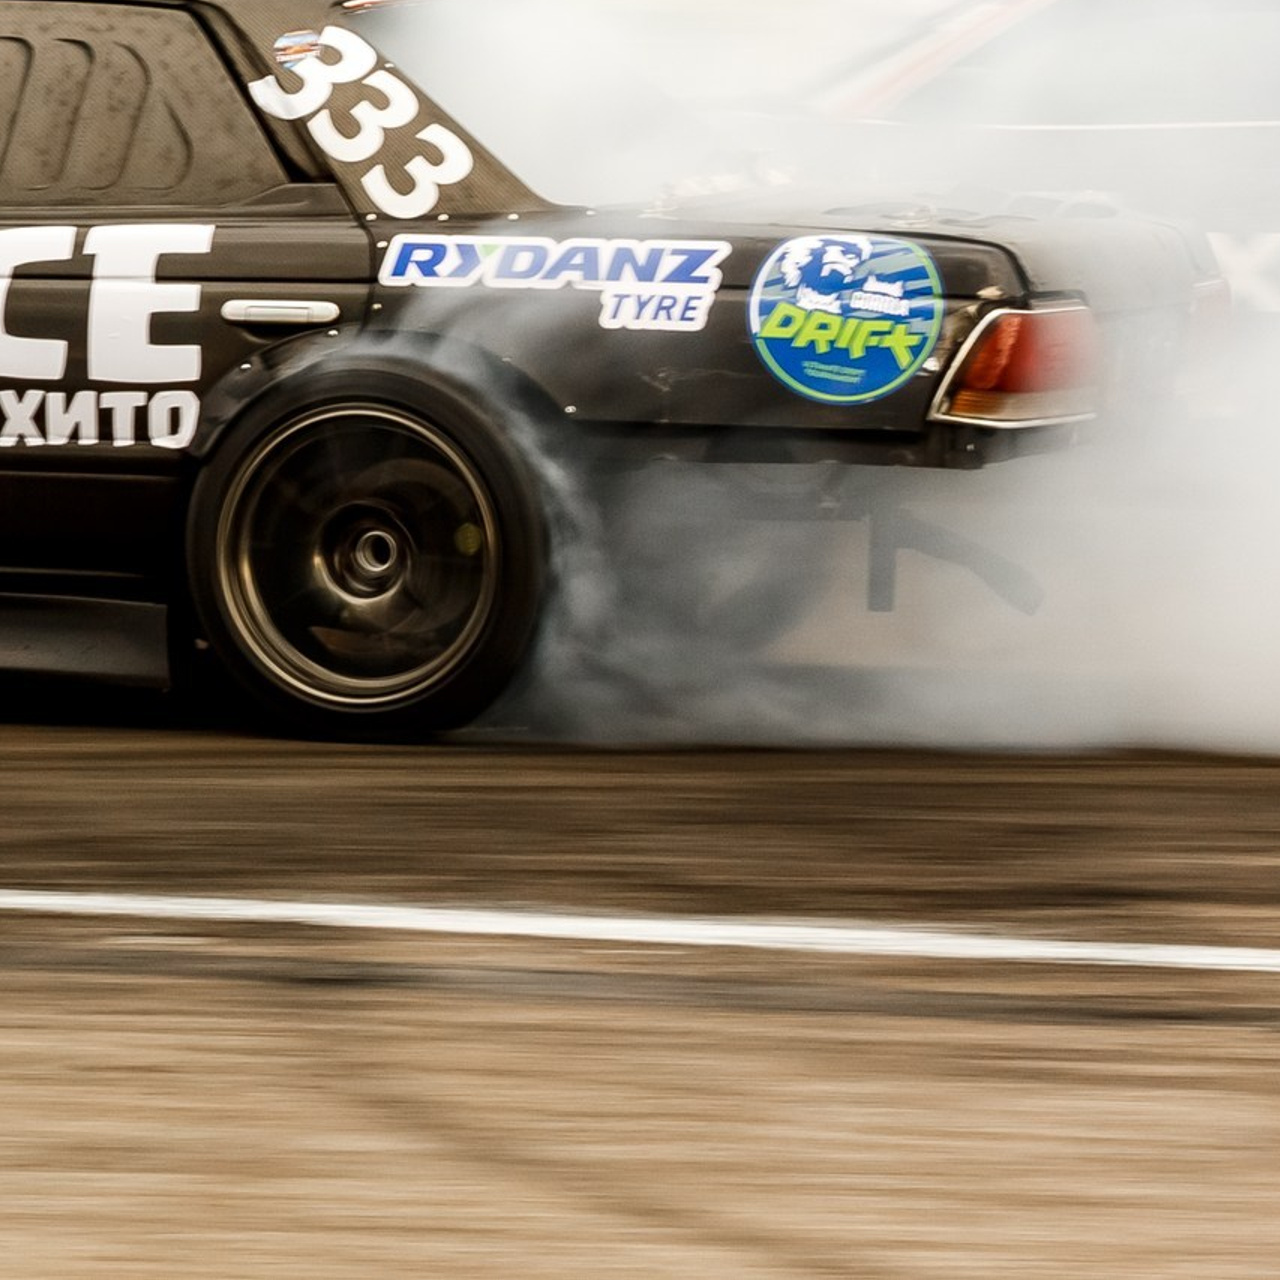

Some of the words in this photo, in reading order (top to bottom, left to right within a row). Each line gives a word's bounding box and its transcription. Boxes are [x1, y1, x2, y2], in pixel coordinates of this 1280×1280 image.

[247, 25, 475, 220] 333
[390, 241, 720, 285] RYDANZ
[609, 293, 704, 322] TYRE
[758, 301, 924, 371] DRIFT
